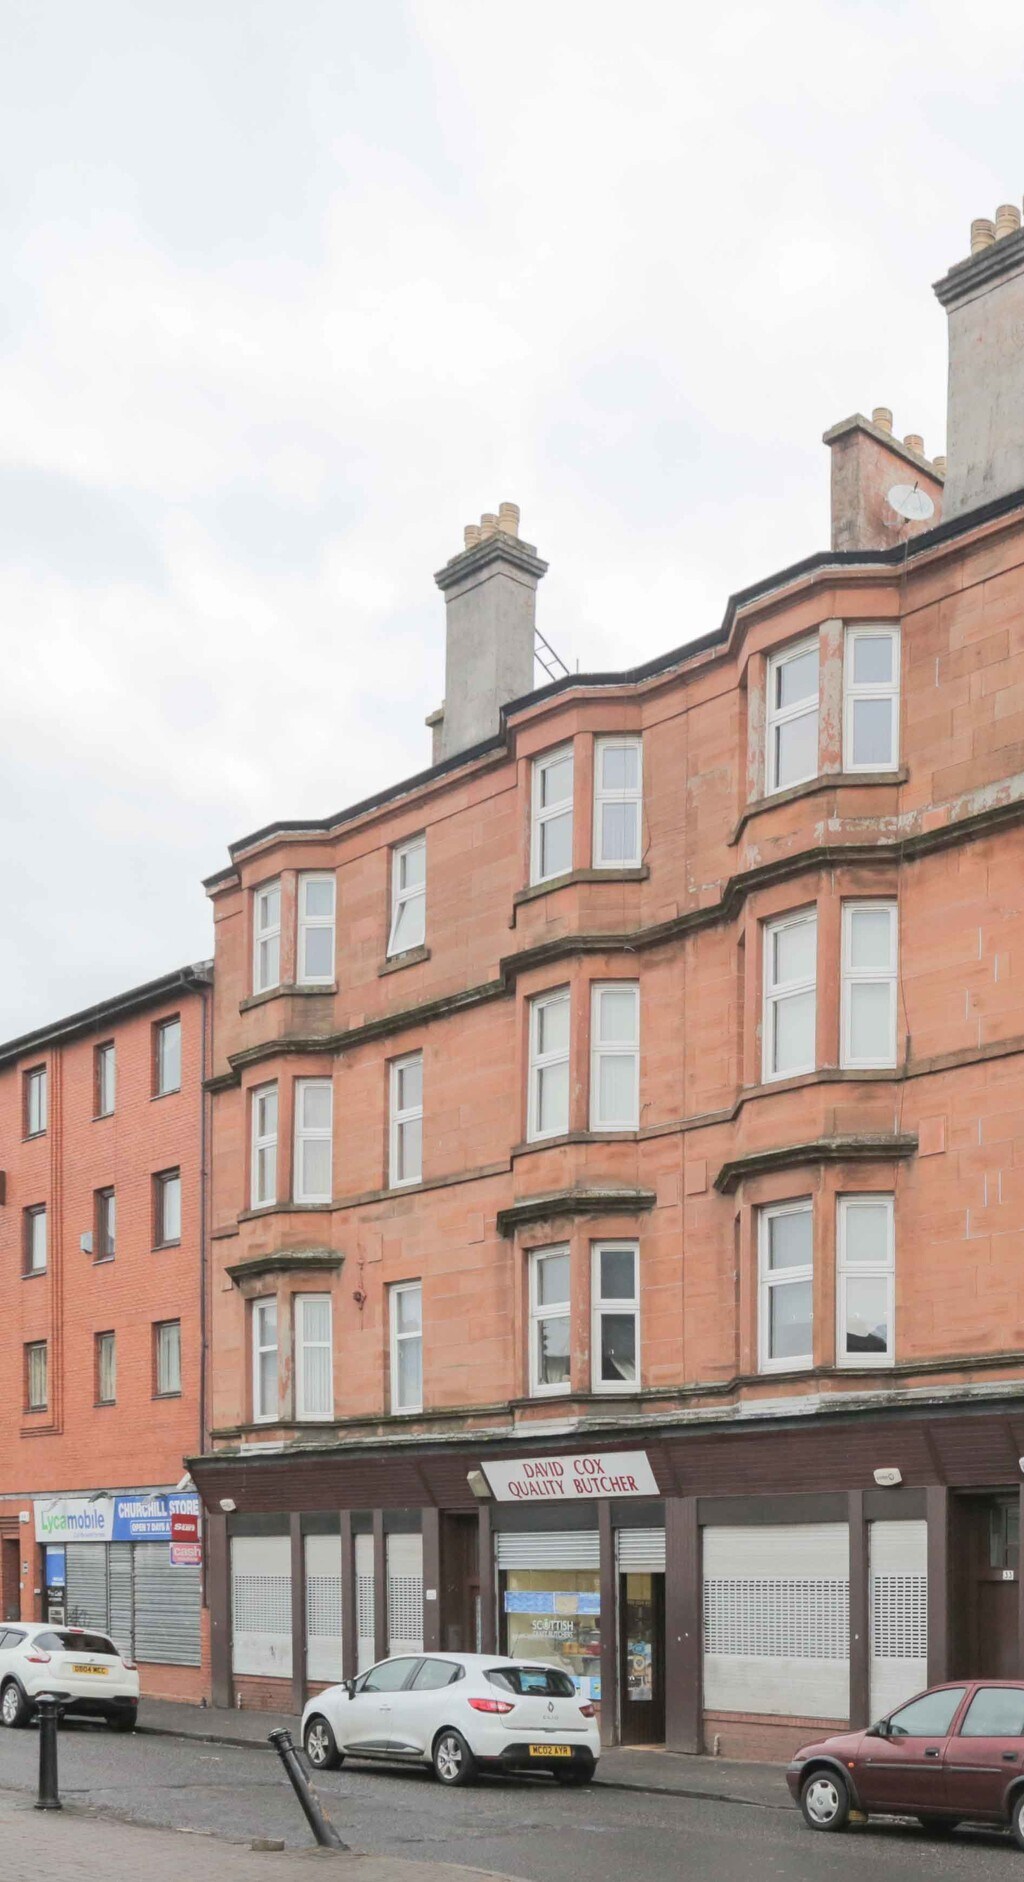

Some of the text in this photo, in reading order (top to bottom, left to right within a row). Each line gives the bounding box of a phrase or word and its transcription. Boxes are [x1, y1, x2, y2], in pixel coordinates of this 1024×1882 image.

[523, 1458, 605, 1478] DAVID COX
[508, 1475, 639, 1499] QUALITY BUTCHER
[118, 1501, 167, 1519] CHURCHILL
[41, 1509, 105, 1534] Lycamobile
[131, 1522, 146, 1533] OPEN
[147, 1522, 151, 1532] 7
[151, 1522, 166, 1532] DAYS
[532, 1619, 574, 1631] SCOTTISH
[554, 1746, 568, 1755] AYR
